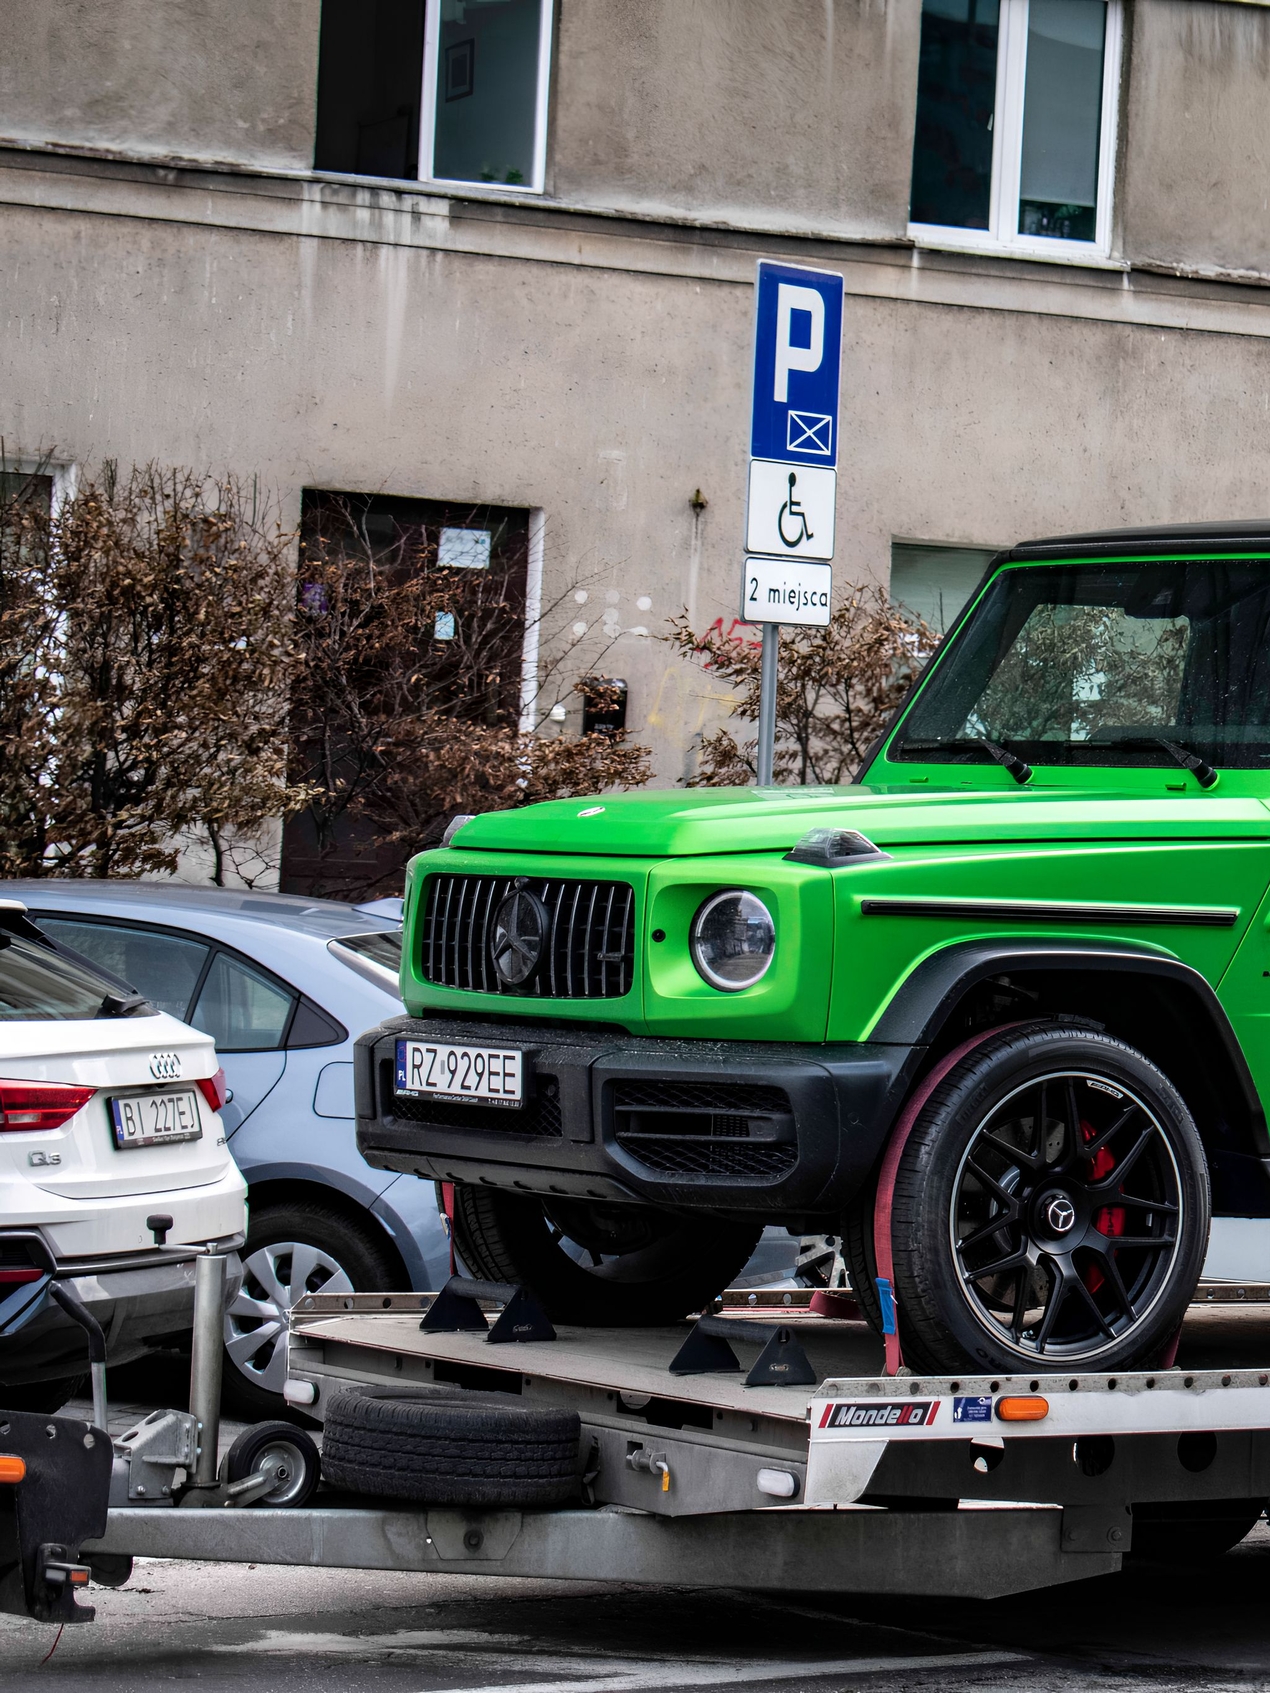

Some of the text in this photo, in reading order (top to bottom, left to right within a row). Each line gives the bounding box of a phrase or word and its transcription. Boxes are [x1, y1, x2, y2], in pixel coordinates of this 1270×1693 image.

[774, 283, 825, 403] P
[749, 577, 829, 611] 2 miejsca
[411, 1046, 516, 1095] RZ 929EE
[123, 1095, 195, 1137] BI 227EJ
[28, 1151, 62, 1167] Q3
[834, 1405, 924, 1426] Mondello
